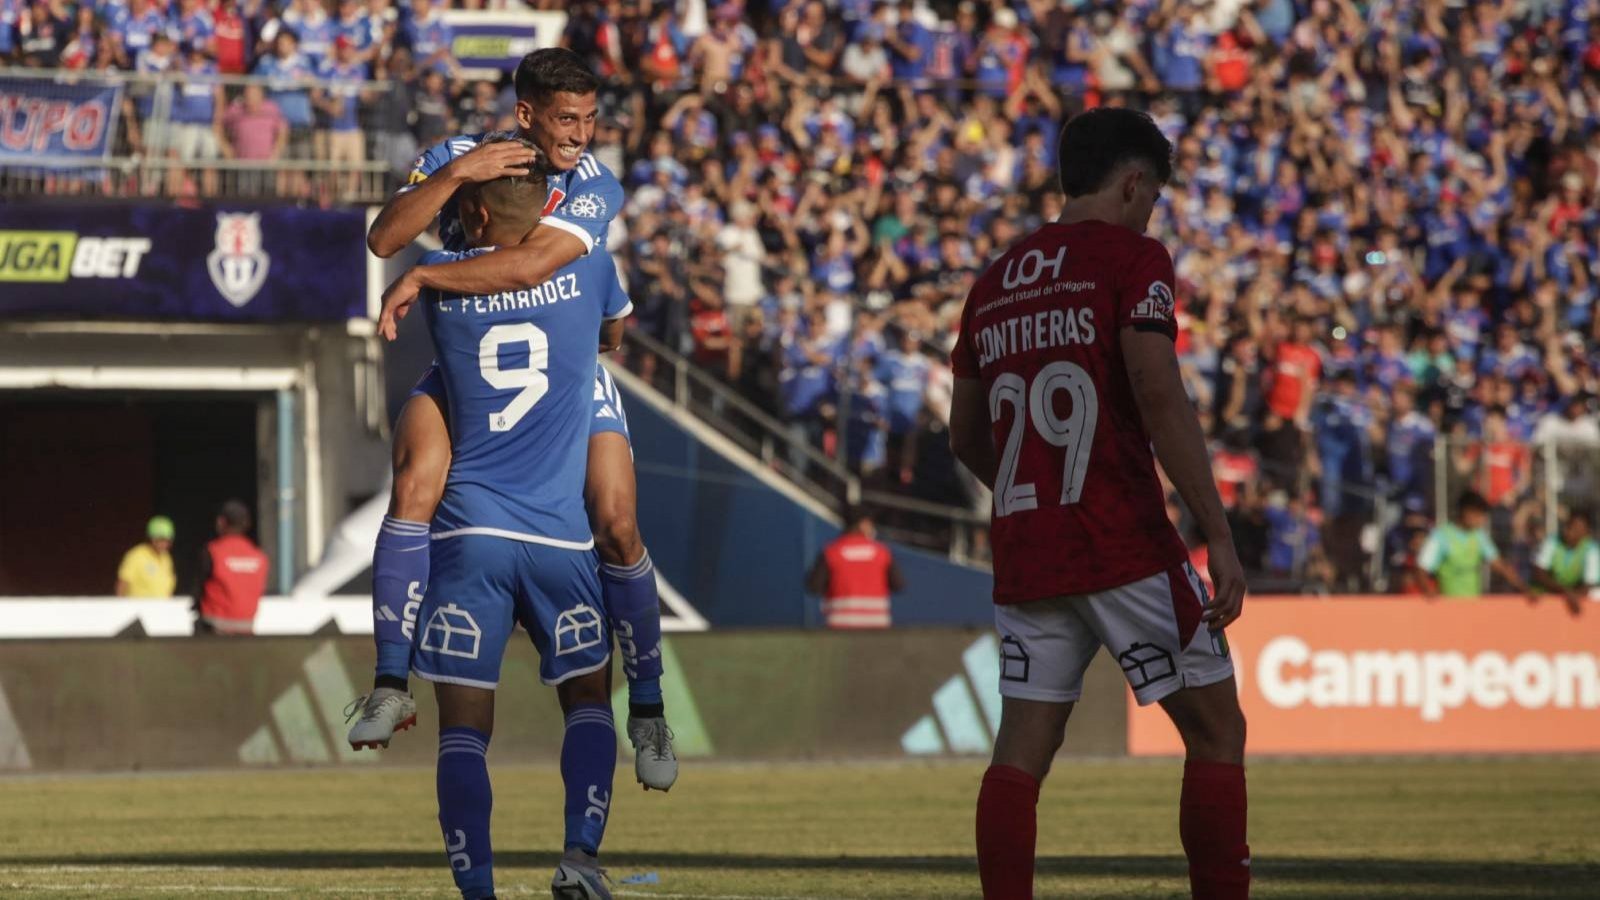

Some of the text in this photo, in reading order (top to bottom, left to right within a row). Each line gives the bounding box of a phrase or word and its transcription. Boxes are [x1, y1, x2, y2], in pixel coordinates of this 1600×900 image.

[0, 94, 107, 152] UPO
[1015, 288, 1041, 302] Estatal
[1043, 286, 1053, 295] de
[1054, 280, 1096, 293] O'Higgins
[974, 307, 1096, 368] CONTRERAS
[478, 322, 549, 432] 9
[988, 360, 1099, 518] 29
[1257, 635, 1600, 722] Campeon
